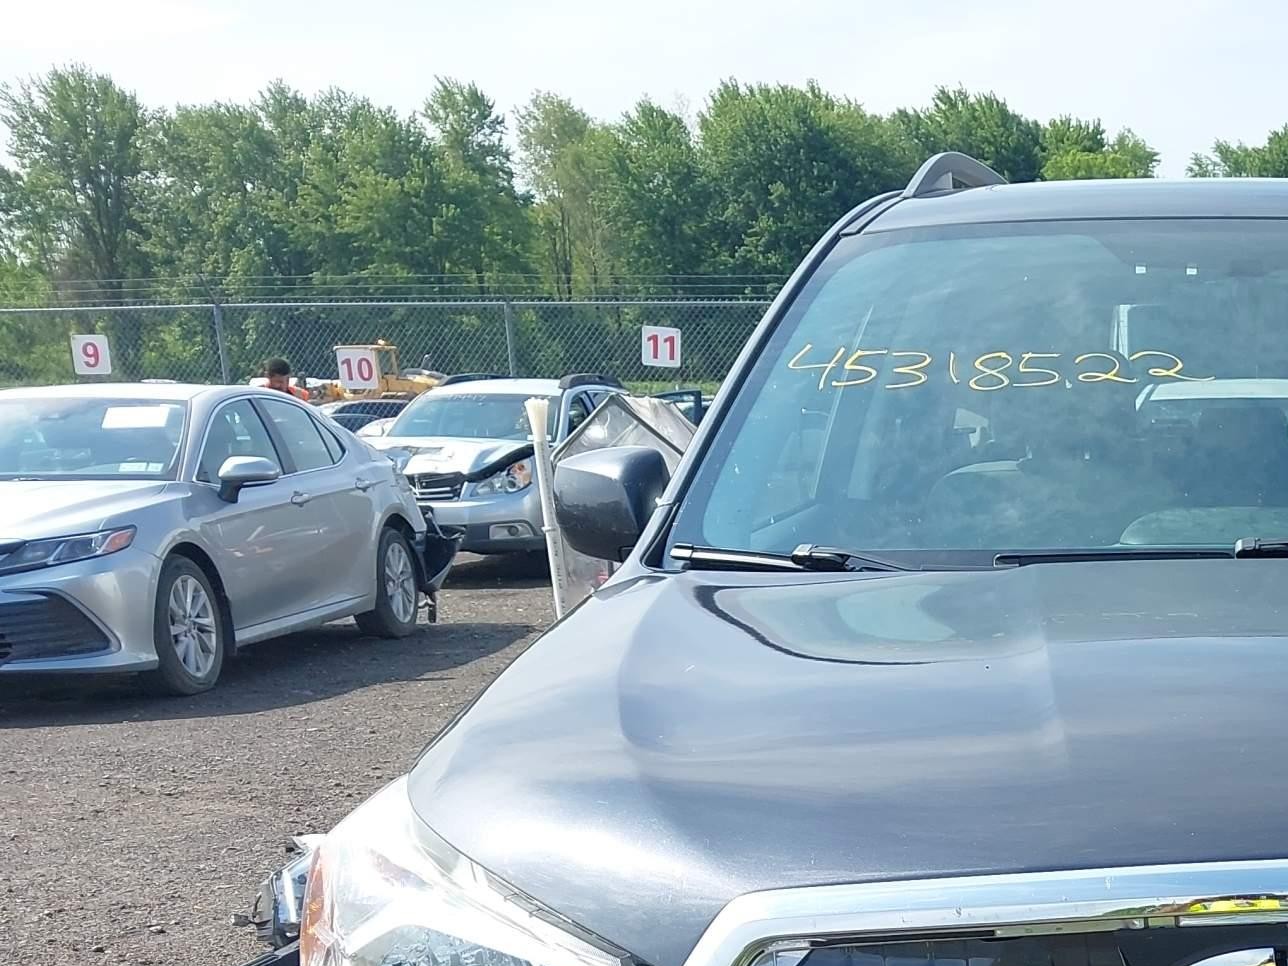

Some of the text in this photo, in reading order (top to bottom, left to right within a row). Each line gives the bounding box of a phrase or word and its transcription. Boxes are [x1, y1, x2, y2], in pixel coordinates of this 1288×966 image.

[82, 342, 99, 368] 9
[647, 334, 675, 361] 11
[340, 357, 373, 382] 10
[788, 344, 1216, 391] 45318522
